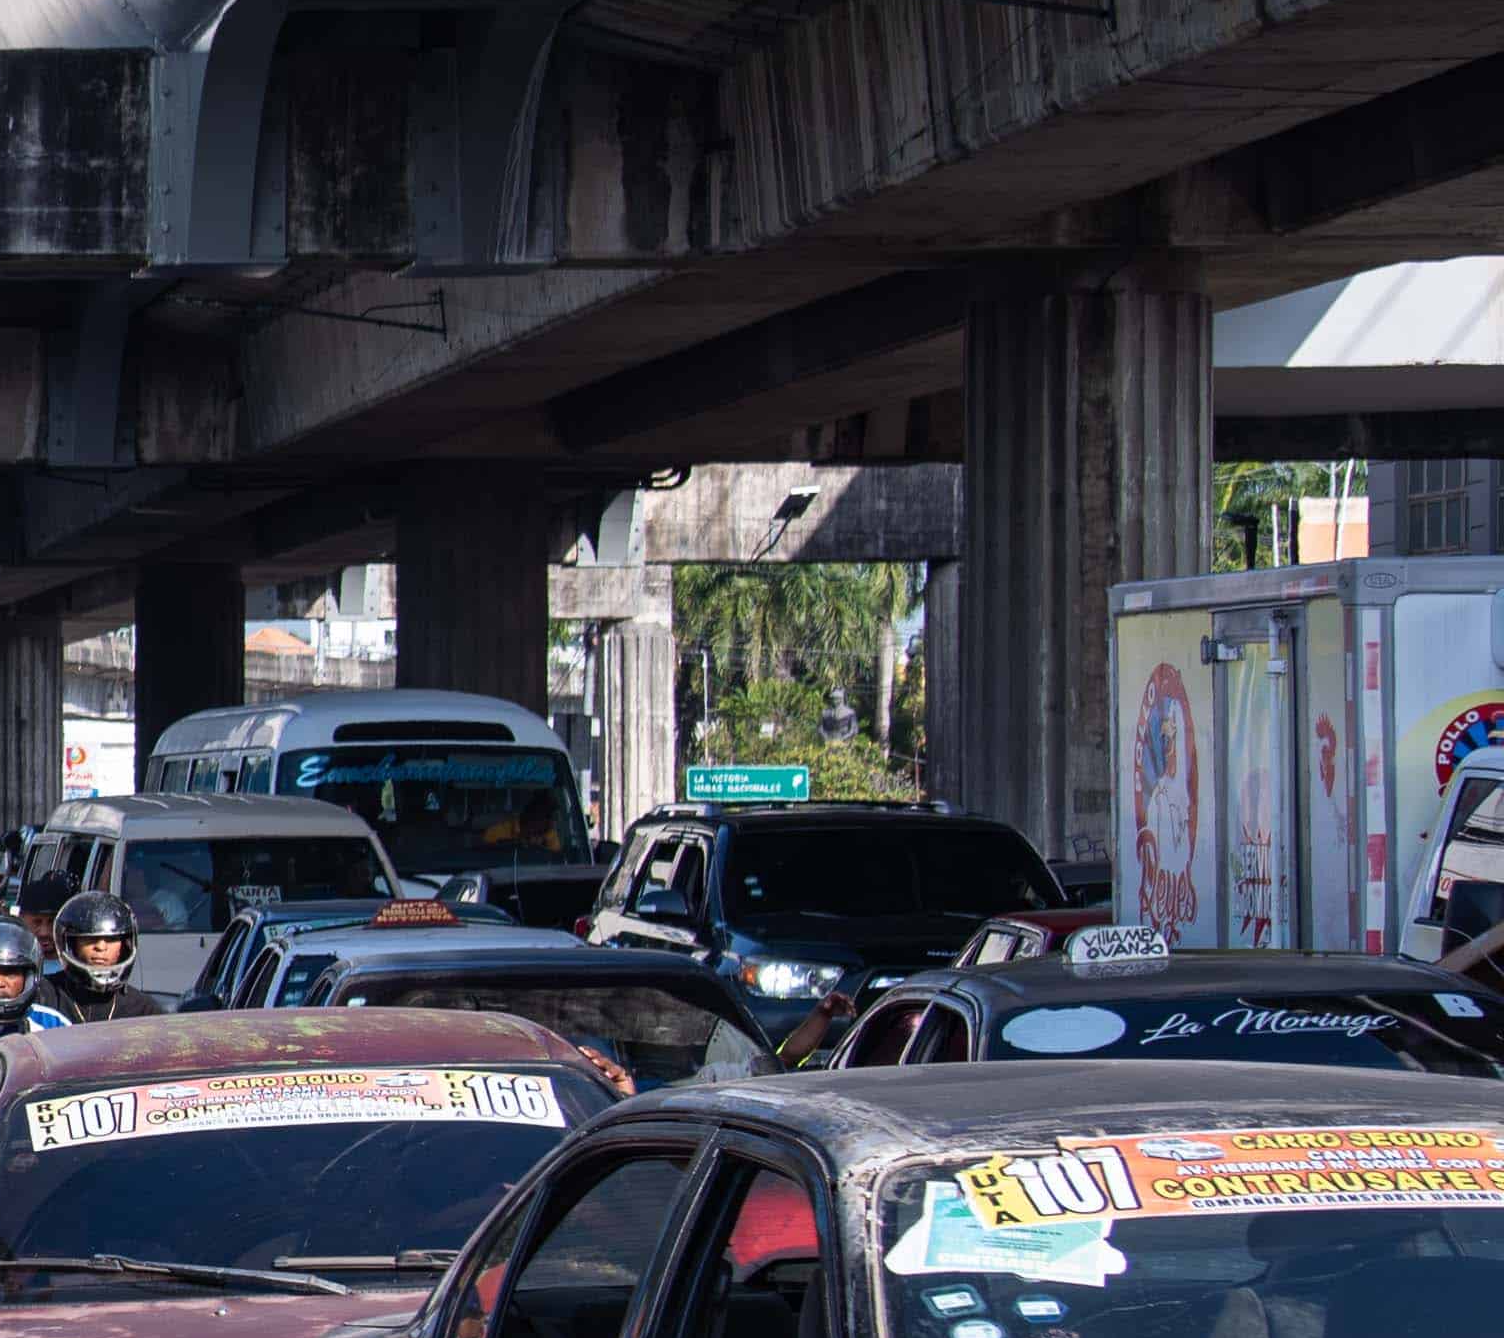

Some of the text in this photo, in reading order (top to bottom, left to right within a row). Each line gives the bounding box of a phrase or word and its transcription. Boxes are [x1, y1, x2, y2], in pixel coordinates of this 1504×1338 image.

[1438, 710, 1481, 765] POLLO
[1139, 1012, 1206, 1045] La
[207, 1073, 367, 1091] CARRO SEGURO
[462, 1074, 549, 1120] 166
[36, 1103, 60, 1147] RUTA
[58, 1091, 138, 1140] 107
[1231, 1130, 1482, 1151] CARRO SEGURO
[999, 1144, 1143, 1217] 107
[1212, 1159, 1326, 1175] HERMANAS
[1436, 1157, 1482, 1170] CON
[1151, 1171, 1483, 1201] CONTRAUSAFE
[1289, 1194, 1309, 1207] DE
[1314, 1191, 1424, 1206] TRANSPORTE
